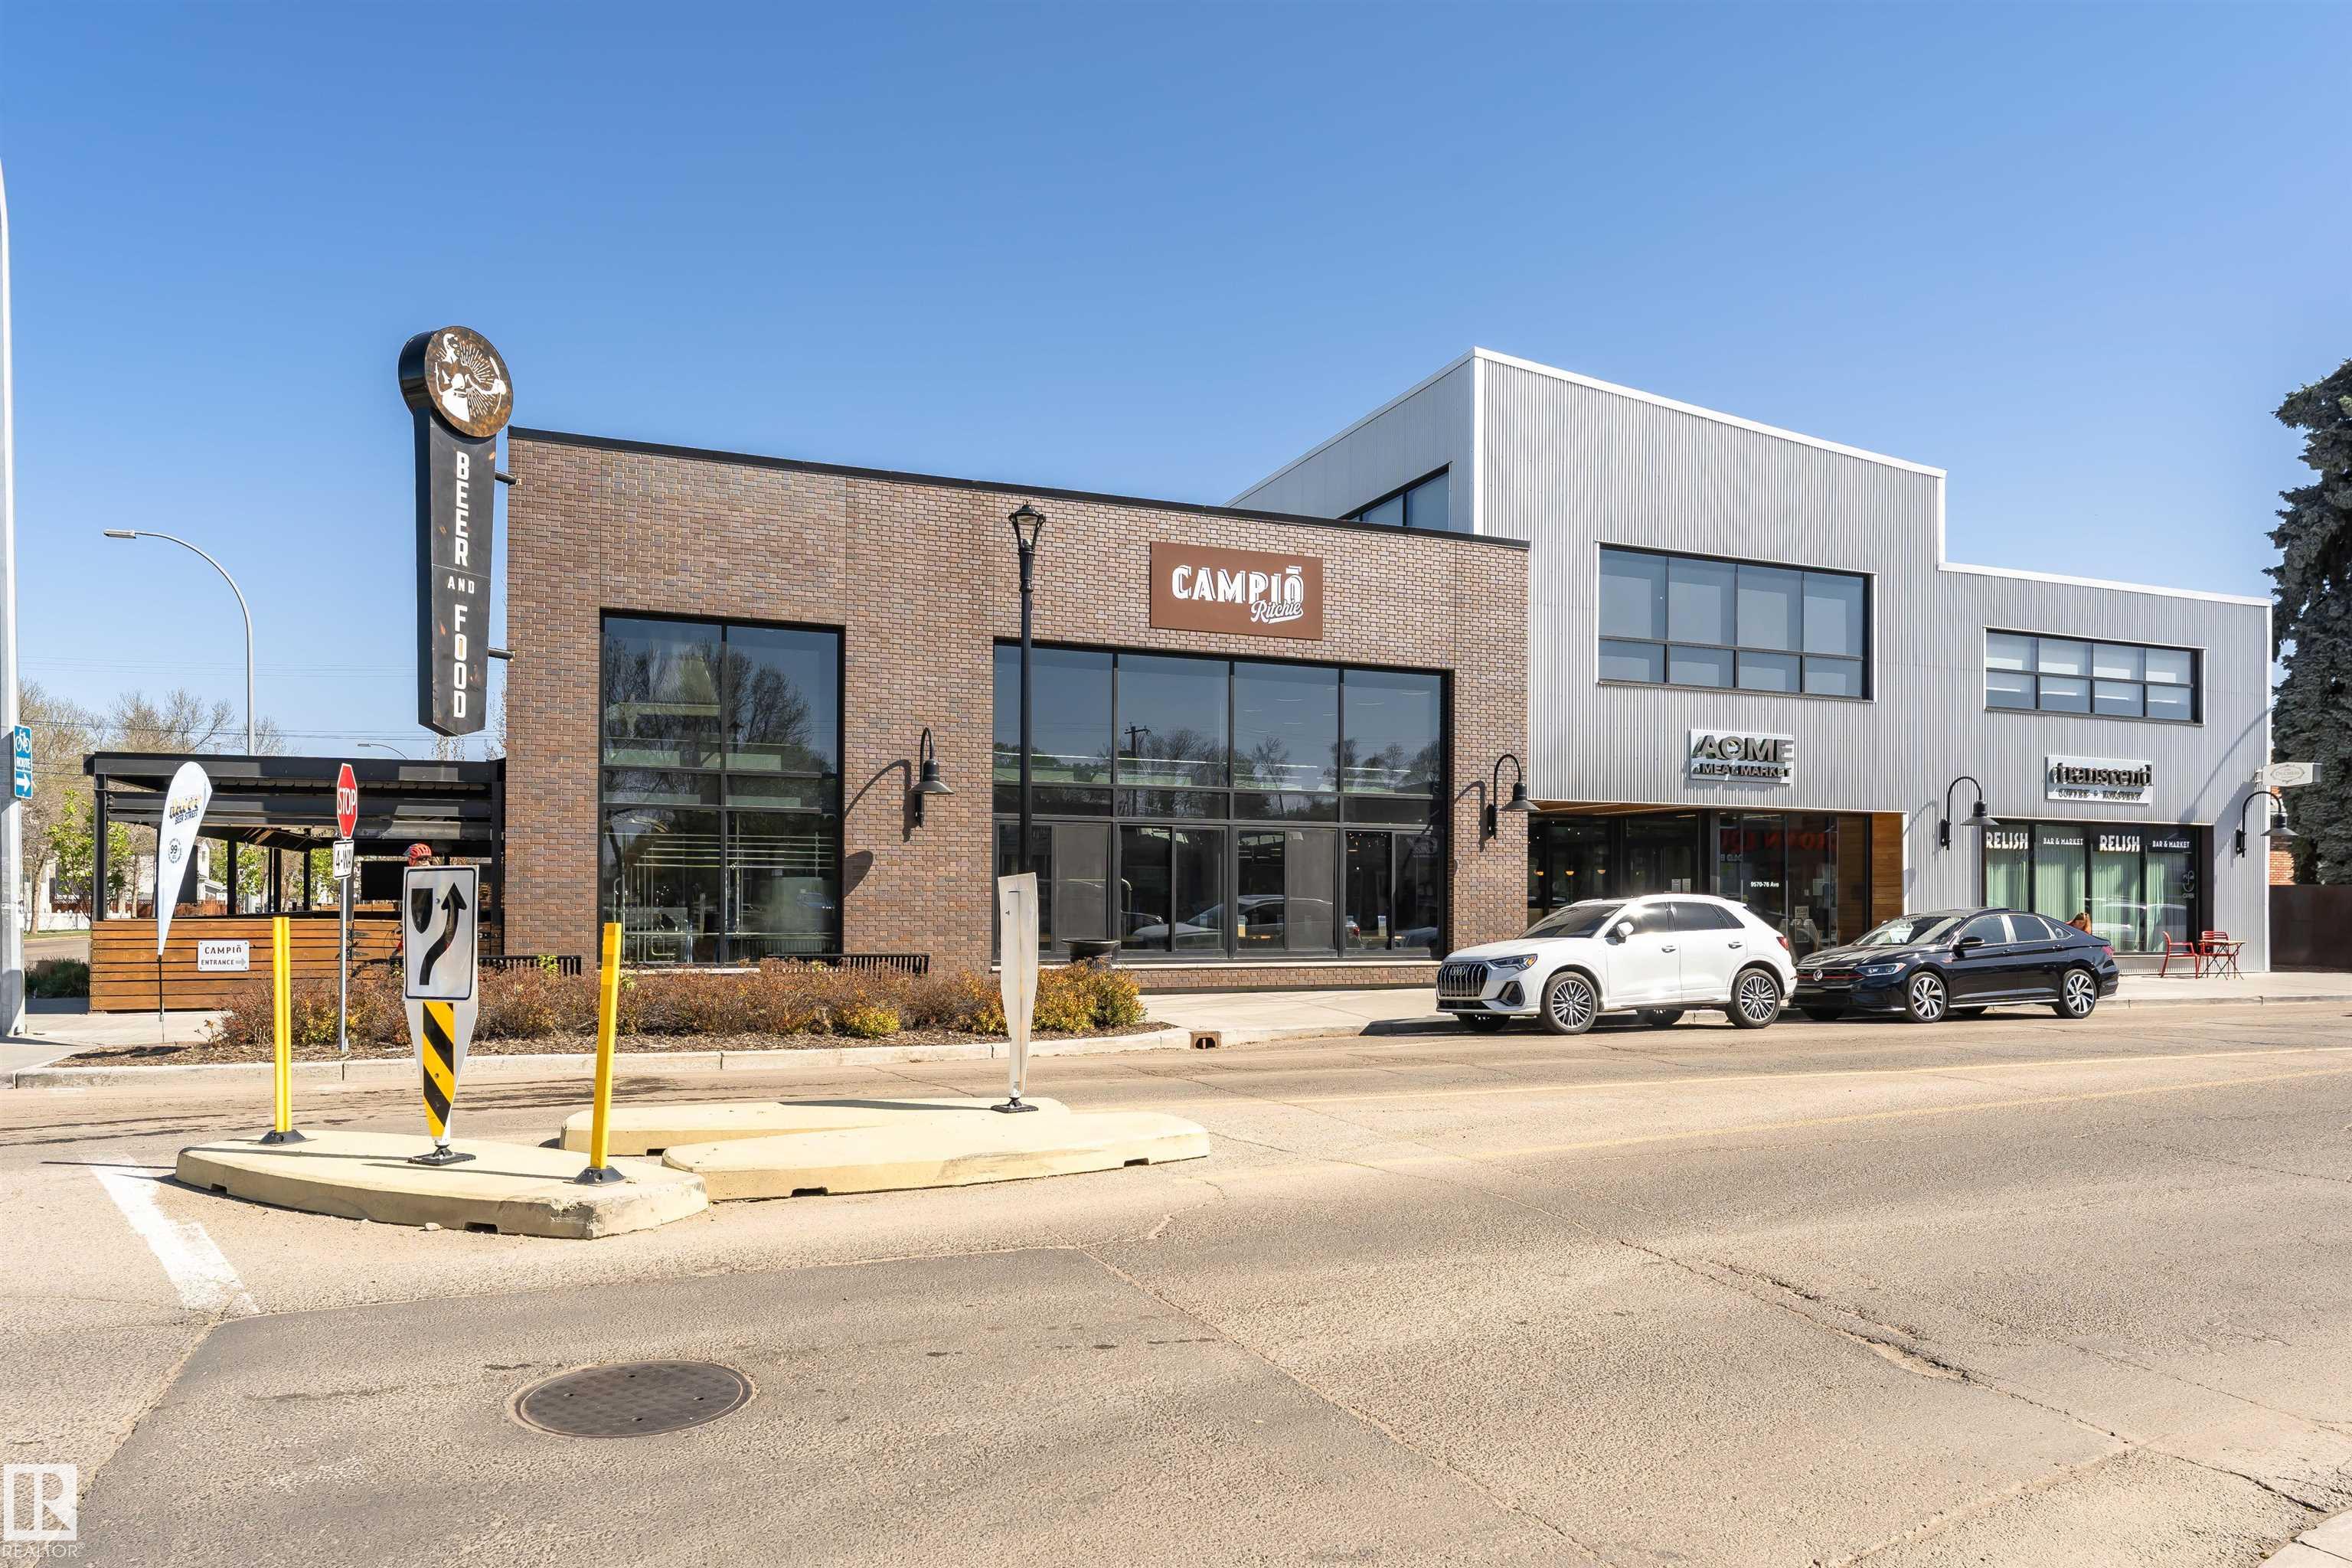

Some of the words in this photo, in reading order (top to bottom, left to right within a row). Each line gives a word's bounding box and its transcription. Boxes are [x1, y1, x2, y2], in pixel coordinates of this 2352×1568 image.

[454, 450, 469, 567] BEER
[447, 575, 475, 595] AND
[1250, 599, 1304, 624] Ritchie
[453, 603, 469, 718] FOOD
[1693, 734, 1794, 763] ACME
[16, 756, 31, 769] ROUTE
[1699, 763, 1736, 775] MEAT
[1740, 765, 1792, 777] MARKET
[2055, 762, 2153, 786] transcend
[338, 787, 357, 815] STOP
[1986, 831, 2029, 850] RELISH
[2043, 837, 2054, 845] BAR
[2099, 835, 2141, 852] RELISH
